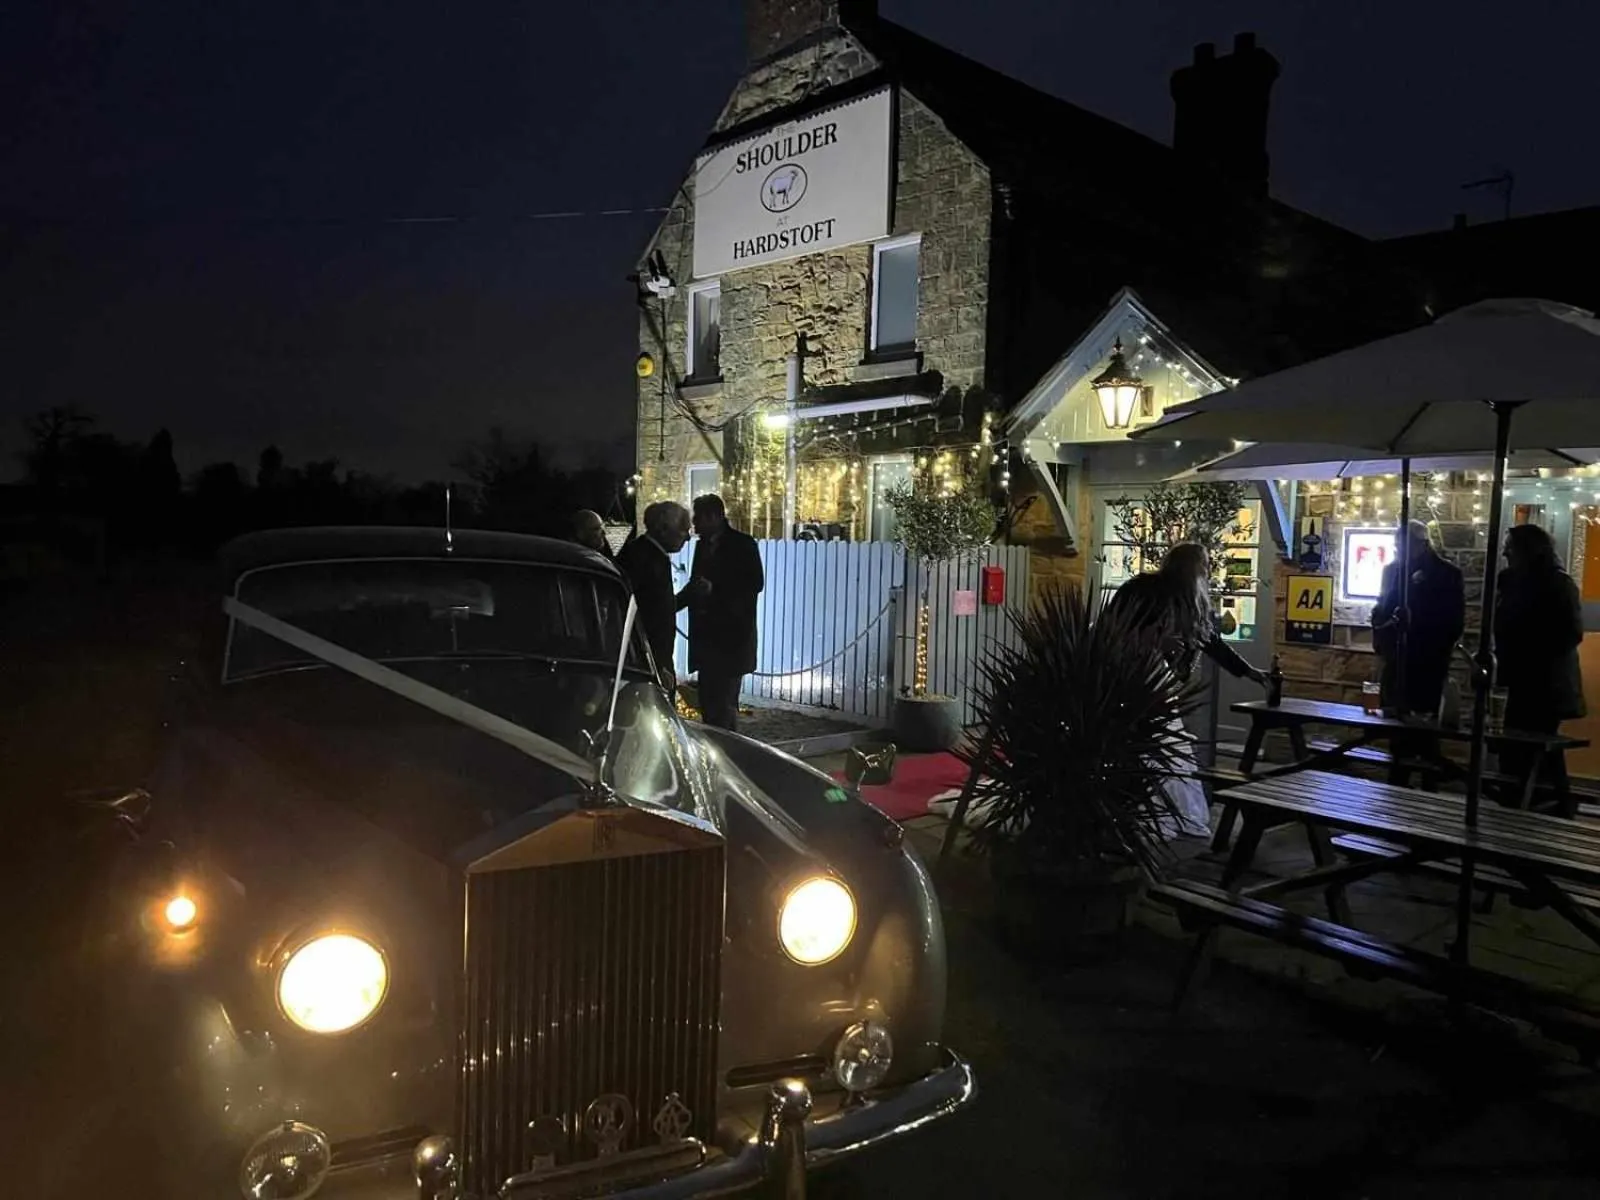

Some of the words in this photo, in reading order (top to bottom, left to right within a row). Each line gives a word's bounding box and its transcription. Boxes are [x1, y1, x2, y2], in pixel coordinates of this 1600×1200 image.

[736, 122, 838, 174] SHOULDER
[776, 215, 790, 227] AT
[733, 218, 836, 260] HARDSTOFT
[1296, 588, 1324, 609] AA
